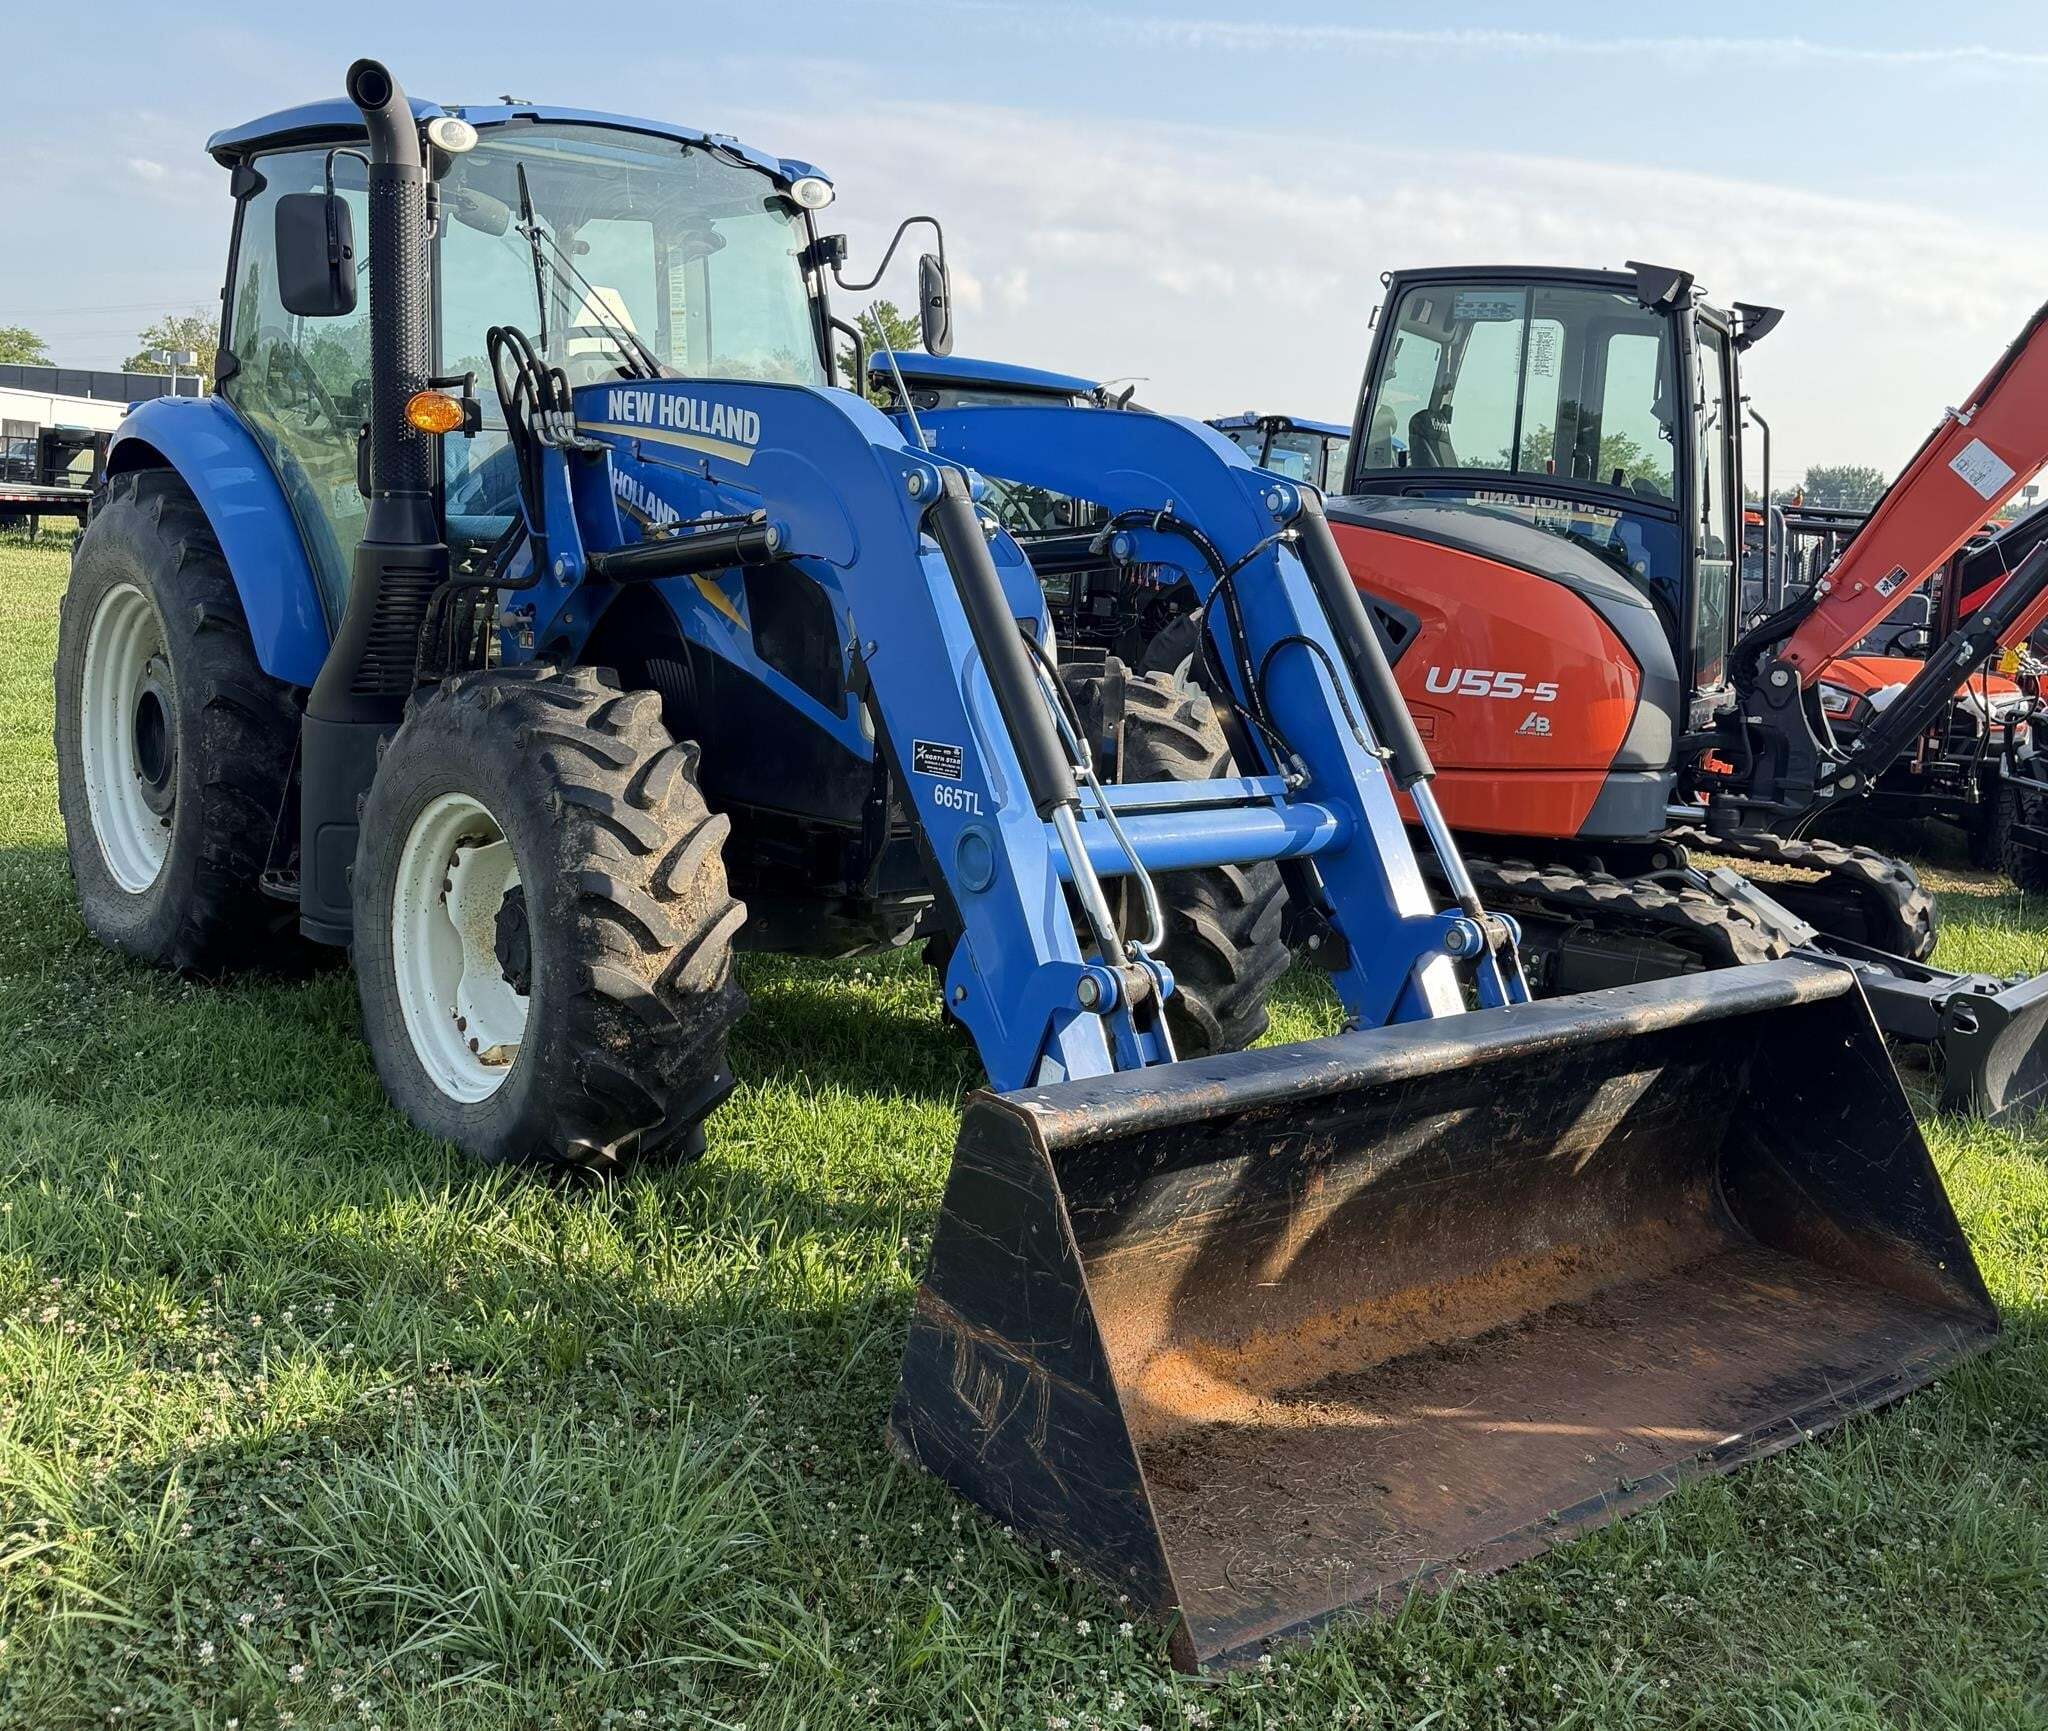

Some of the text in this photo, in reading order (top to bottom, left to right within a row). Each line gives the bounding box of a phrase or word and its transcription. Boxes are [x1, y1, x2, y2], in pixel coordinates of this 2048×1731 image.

[608, 390, 760, 445] NEW HOLLAND
[612, 467, 680, 536] HOLLAND
[1425, 666, 1560, 702] U55-5
[1519, 711, 1550, 732] AB
[934, 784, 984, 816] 665TL
